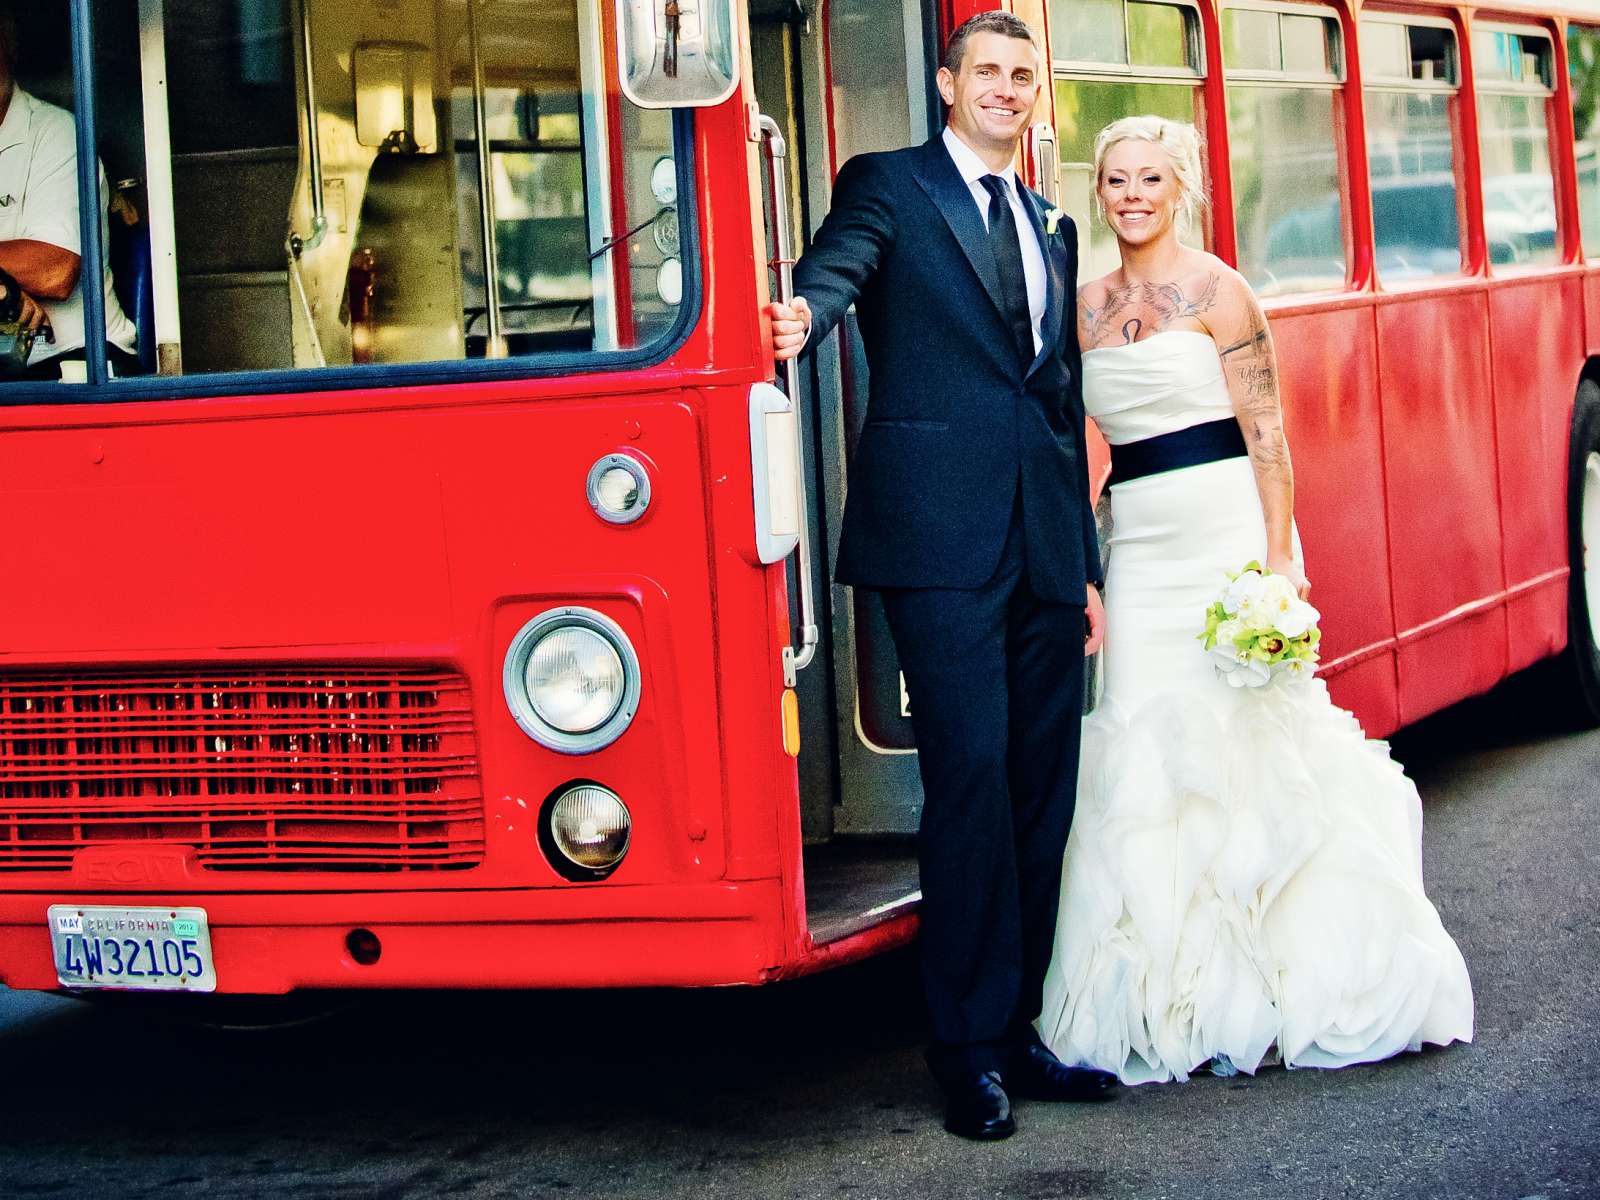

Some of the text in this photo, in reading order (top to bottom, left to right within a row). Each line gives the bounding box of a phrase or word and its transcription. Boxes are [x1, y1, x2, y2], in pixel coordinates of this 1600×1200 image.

[59, 918, 80, 930] MAY
[87, 919, 170, 932] CALIFORNIA
[65, 937, 203, 977] 4W32105
